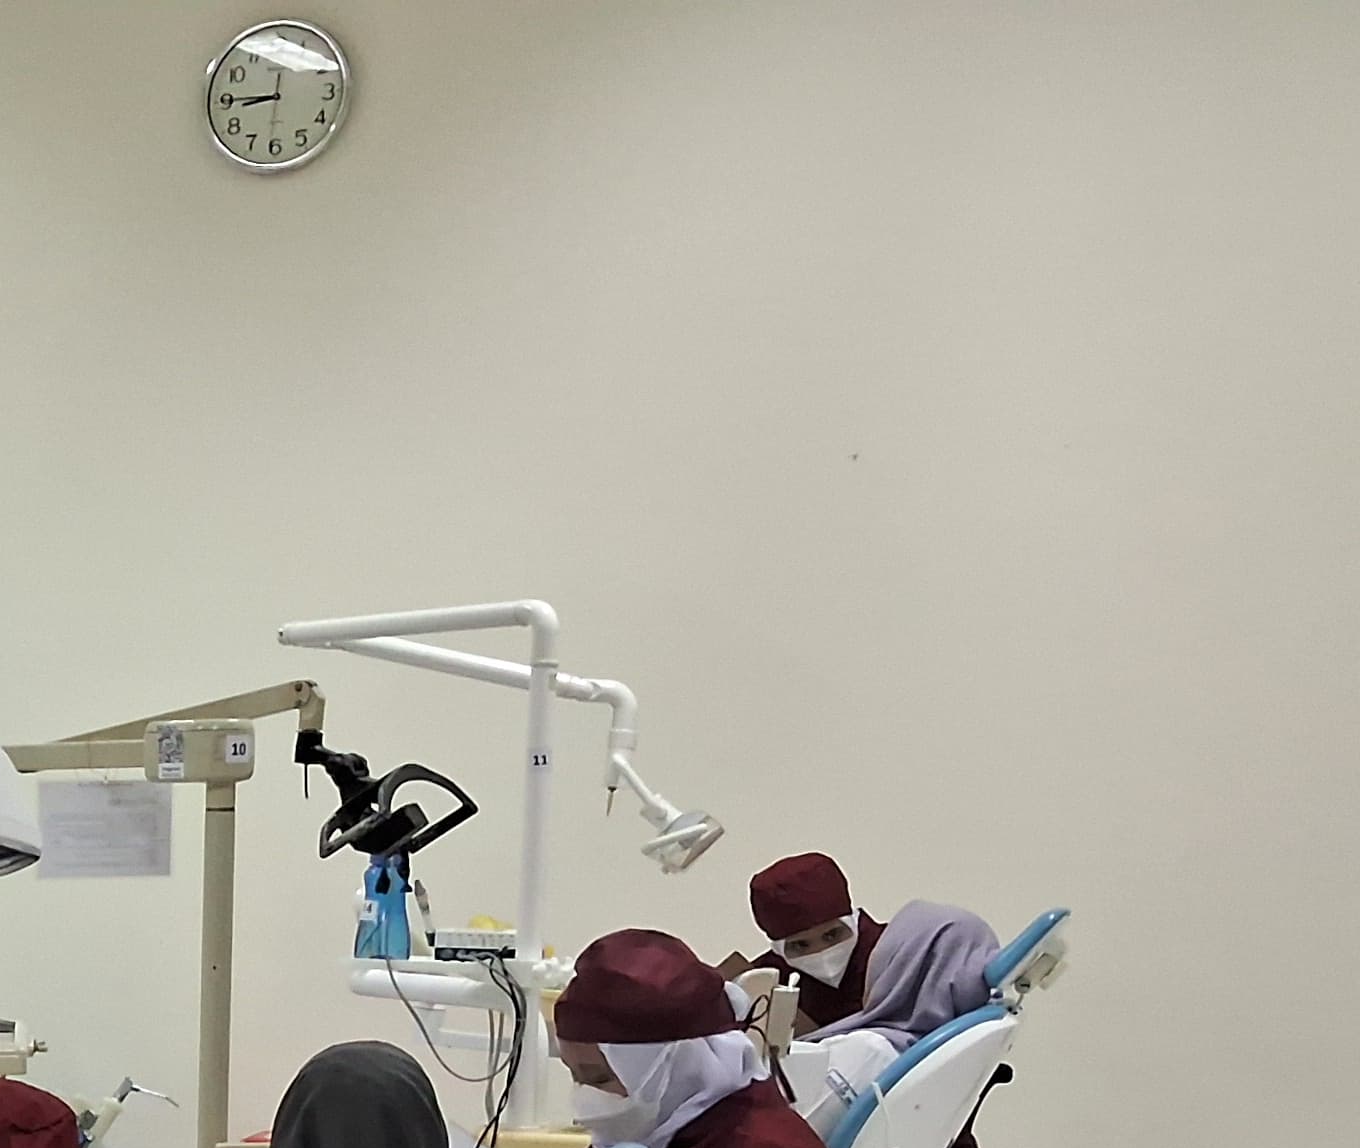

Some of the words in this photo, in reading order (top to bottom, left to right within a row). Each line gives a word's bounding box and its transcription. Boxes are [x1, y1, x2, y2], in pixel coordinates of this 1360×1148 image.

[229, 65, 246, 83] 10
[322, 83, 335, 100] 3
[220, 94, 233, 110] 9
[314, 108, 326, 125] 4
[227, 117, 240, 135] 8
[246, 134, 258, 151] 7
[268, 138, 282, 155] 6
[295, 129, 307, 147] 5
[231, 742, 247, 756] 10
[533, 754, 547, 766] 11
